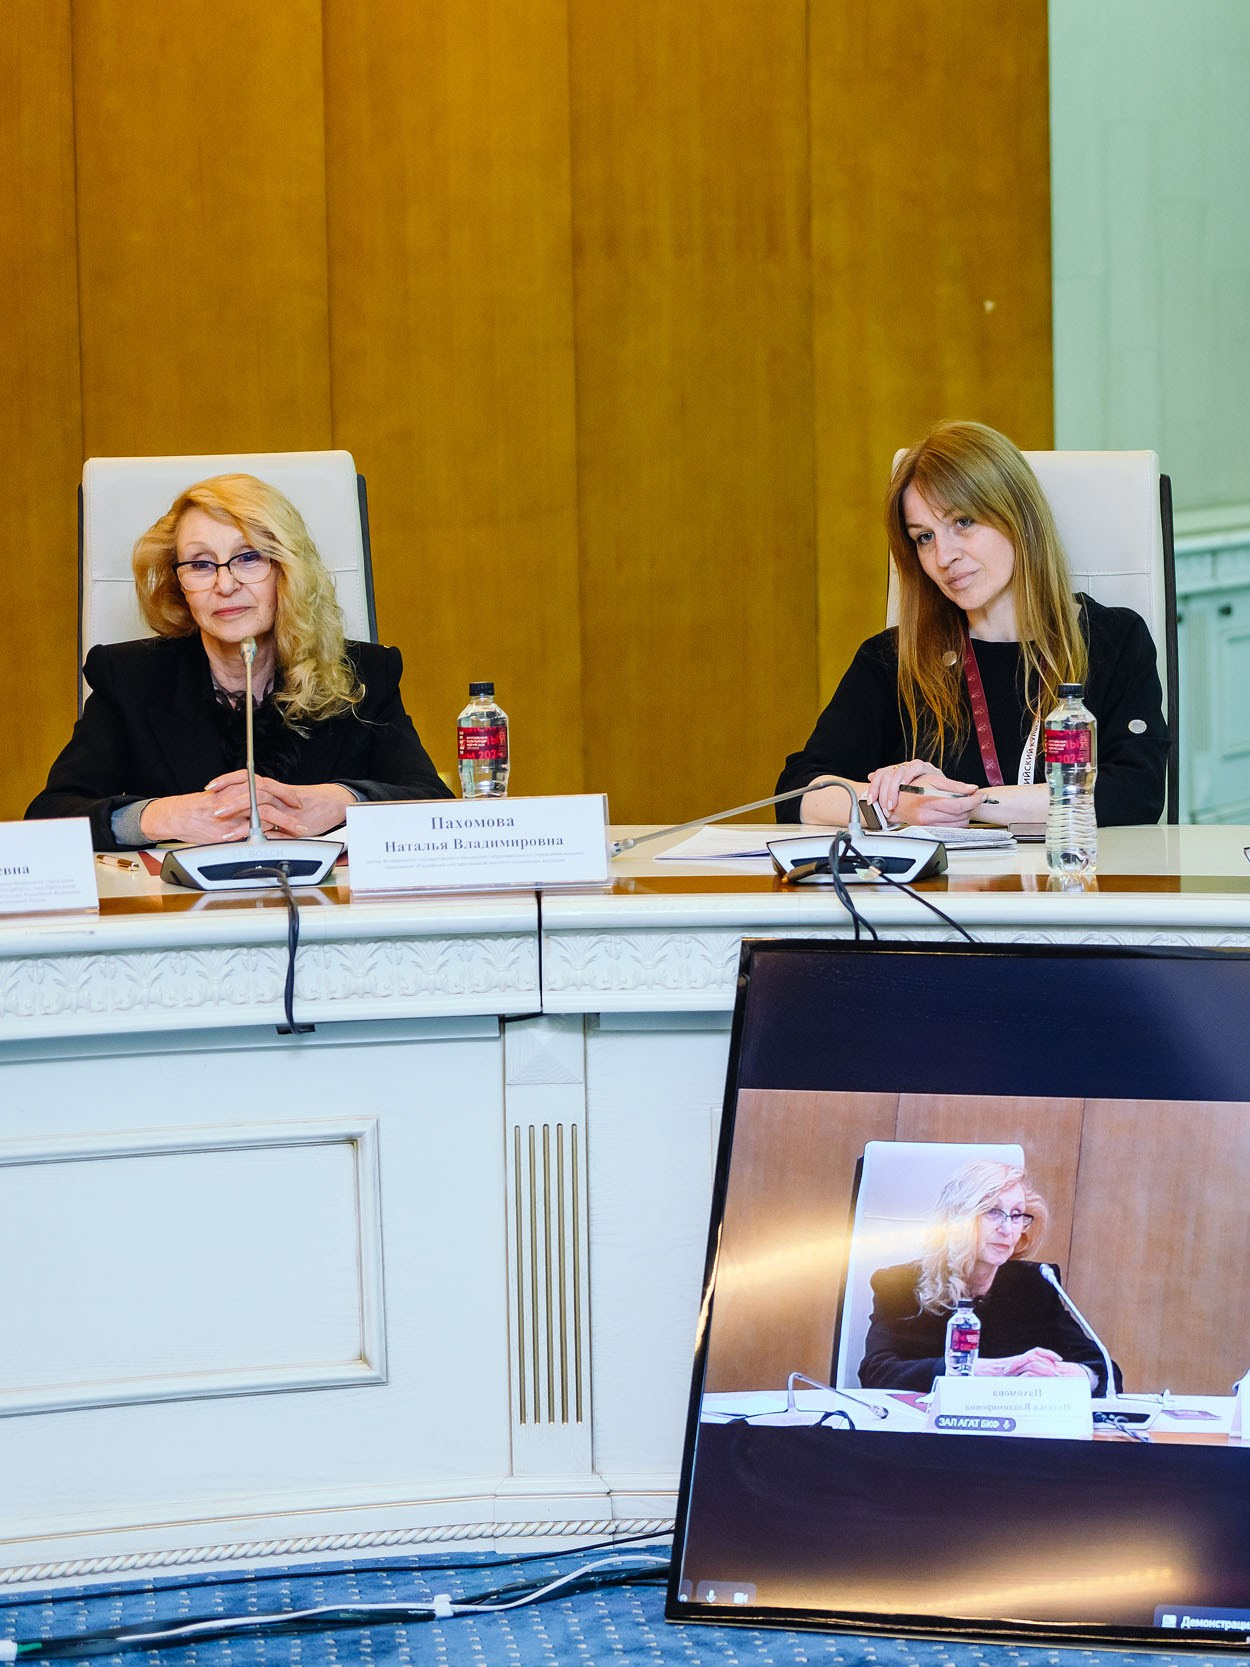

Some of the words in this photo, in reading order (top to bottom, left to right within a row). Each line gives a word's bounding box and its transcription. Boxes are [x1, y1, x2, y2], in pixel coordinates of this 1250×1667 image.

[1022, 748, 1034, 785] ИЙСКИЙ
[431, 815, 515, 831] Пахомова
[385, 840, 448, 853] Наталья
[453, 836, 564, 852] Владимировна
[938, 1417, 957, 1427] ЗАЛ
[957, 1418, 980, 1428] АГАТ
[981, 1419, 1000, 1429] БКФ
